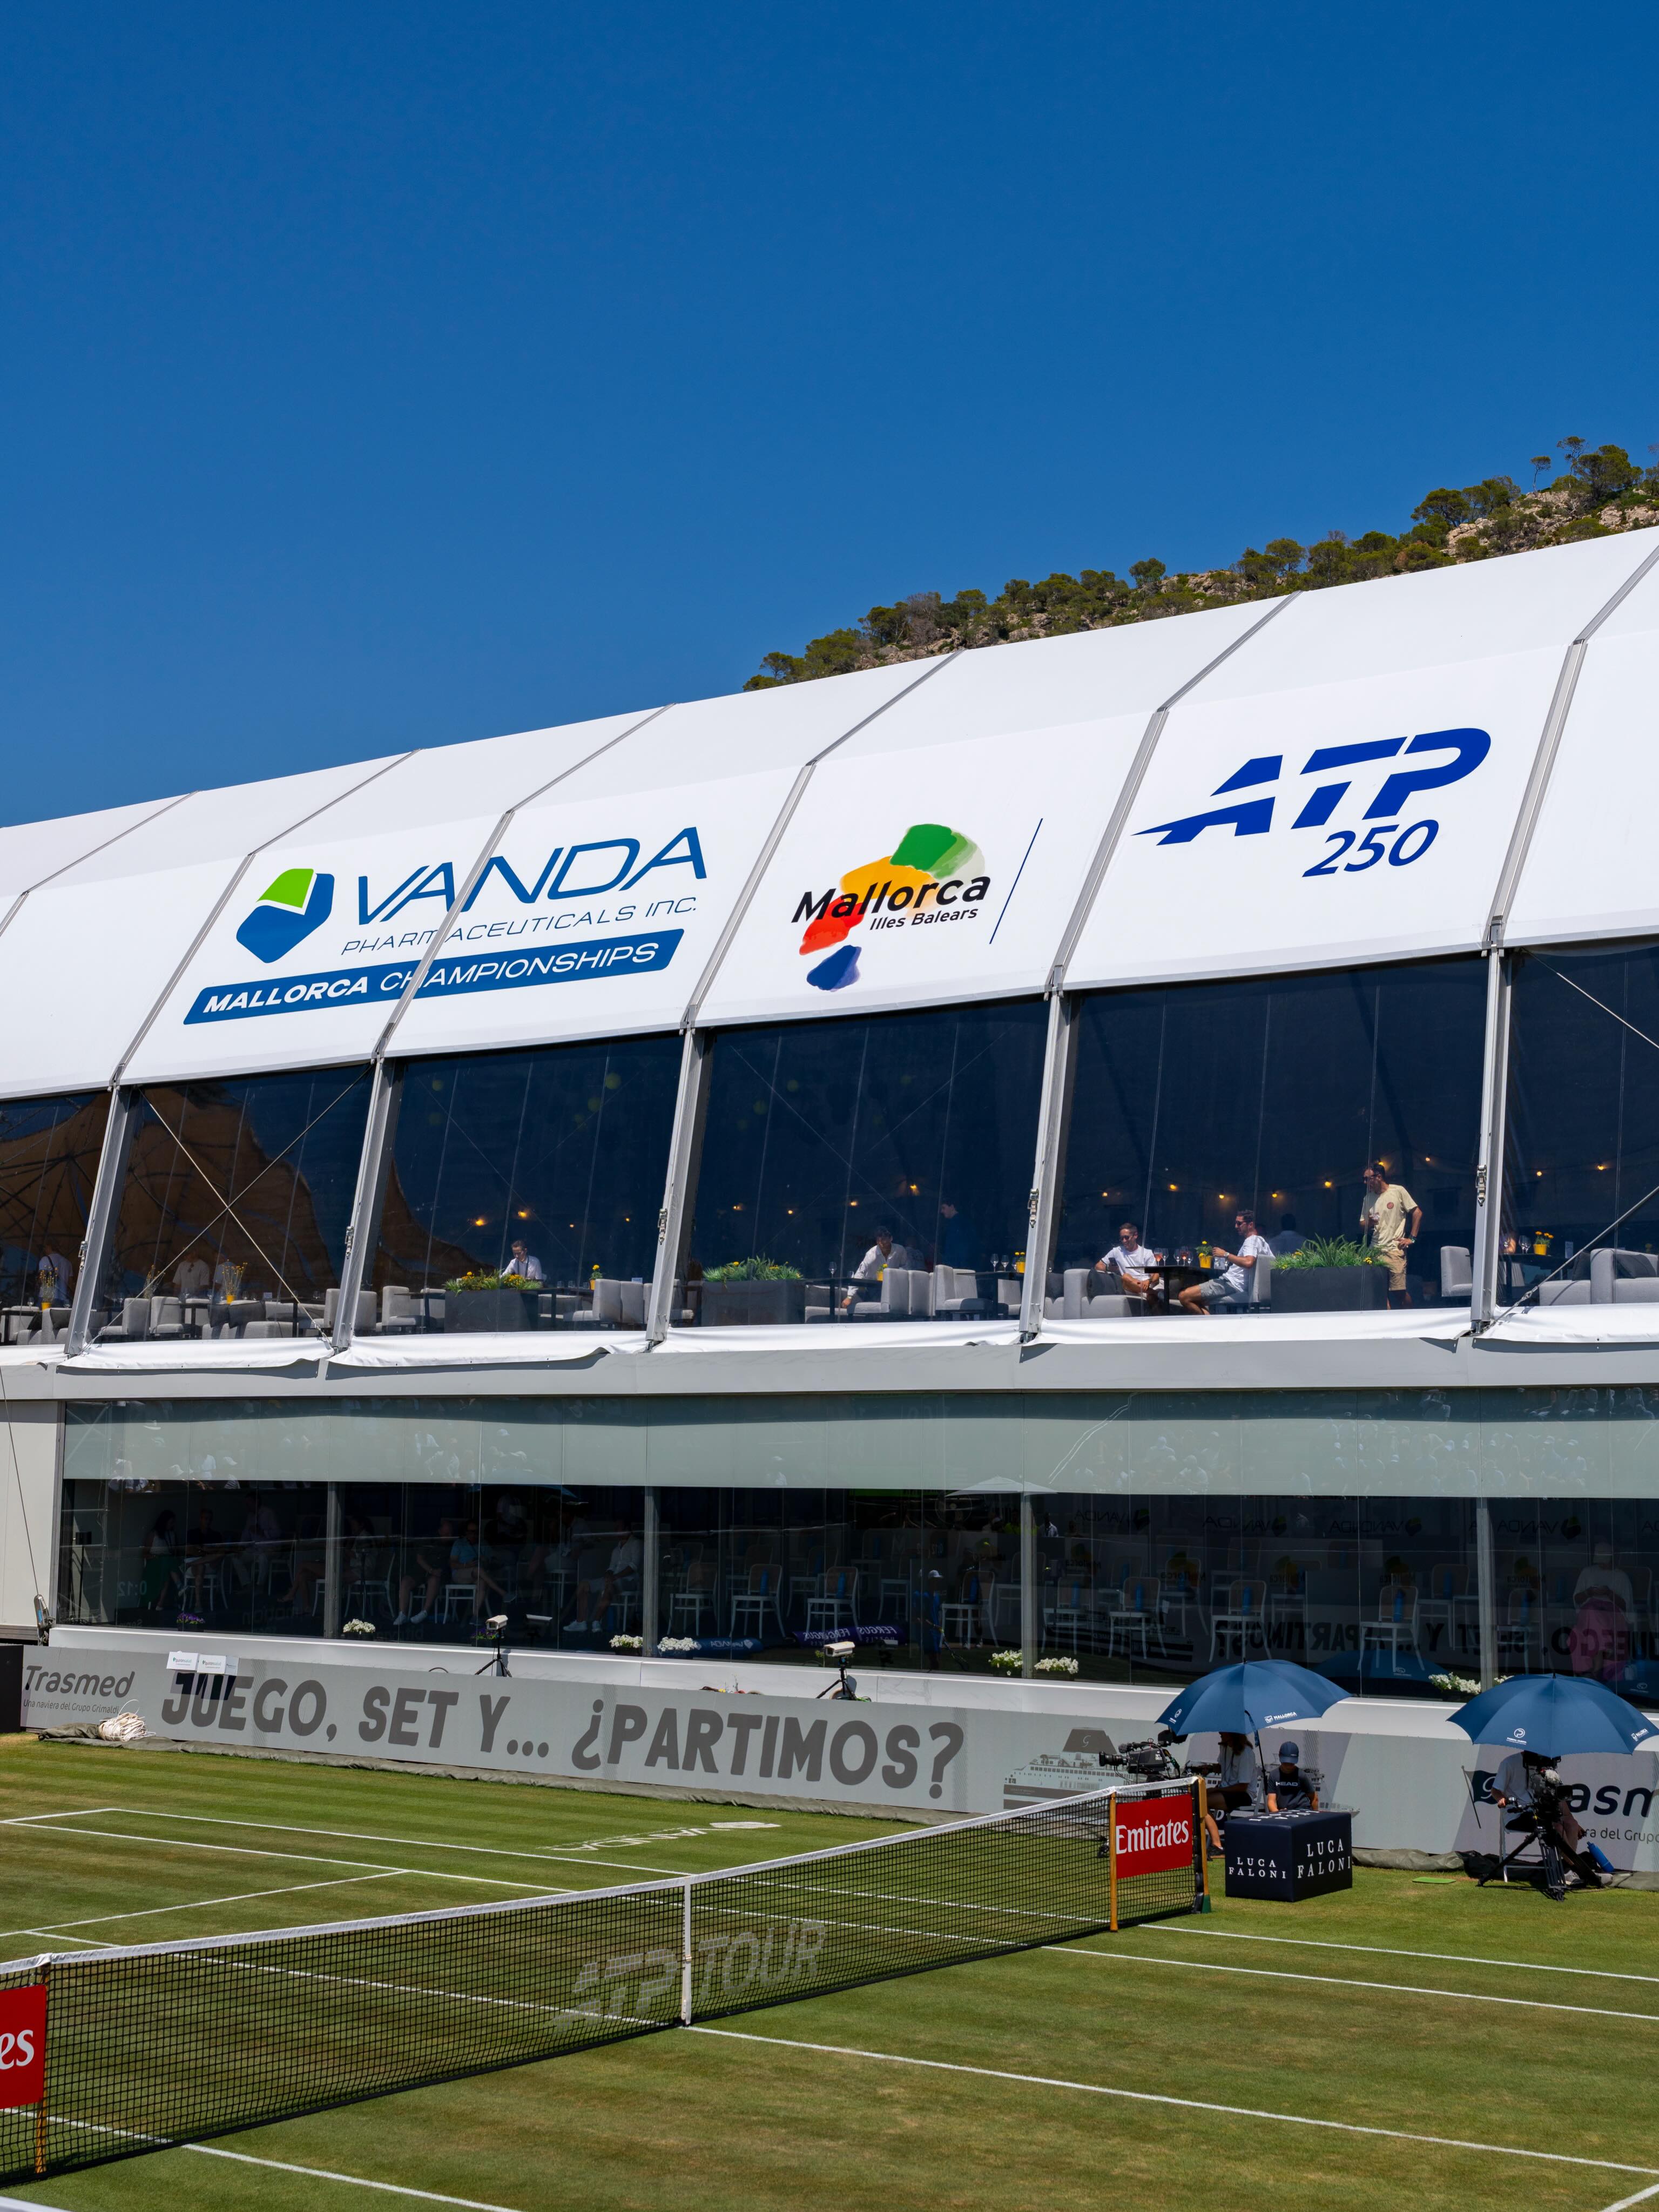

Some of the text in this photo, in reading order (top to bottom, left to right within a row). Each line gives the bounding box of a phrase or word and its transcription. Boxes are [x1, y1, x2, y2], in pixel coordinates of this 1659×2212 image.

[1131, 727, 1491, 846] ATP
[1302, 820, 1440, 878] 250
[358, 826, 707, 926] VANDA
[791, 875, 992, 925] Mallorca
[341, 896, 698, 956] PHARMACEUTICALS INC.
[869, 907, 978, 932] Illes Balears
[203, 942, 659, 1014] MALLORCA CHAMPIONSHIPS
[25, 1665, 135, 1698] Trasmed
[23, 1699, 119, 1714] Una naviera del Grupo Grimaldi
[1273, 1711, 1297, 1721] MALLORCA
[161, 1673, 964, 1799] JUEGO, SET Y... ¿PARTIMOS?
[1116, 1819, 1189, 1854] Emirates
[1307, 1838, 1344, 1857] LUCA
[1600, 1827, 1620, 1840] del
[1229, 1867, 1286, 1879] FALONI
[1237, 1857, 1276, 1867] LUCA
[1297, 1856, 1351, 1879] FALONI
